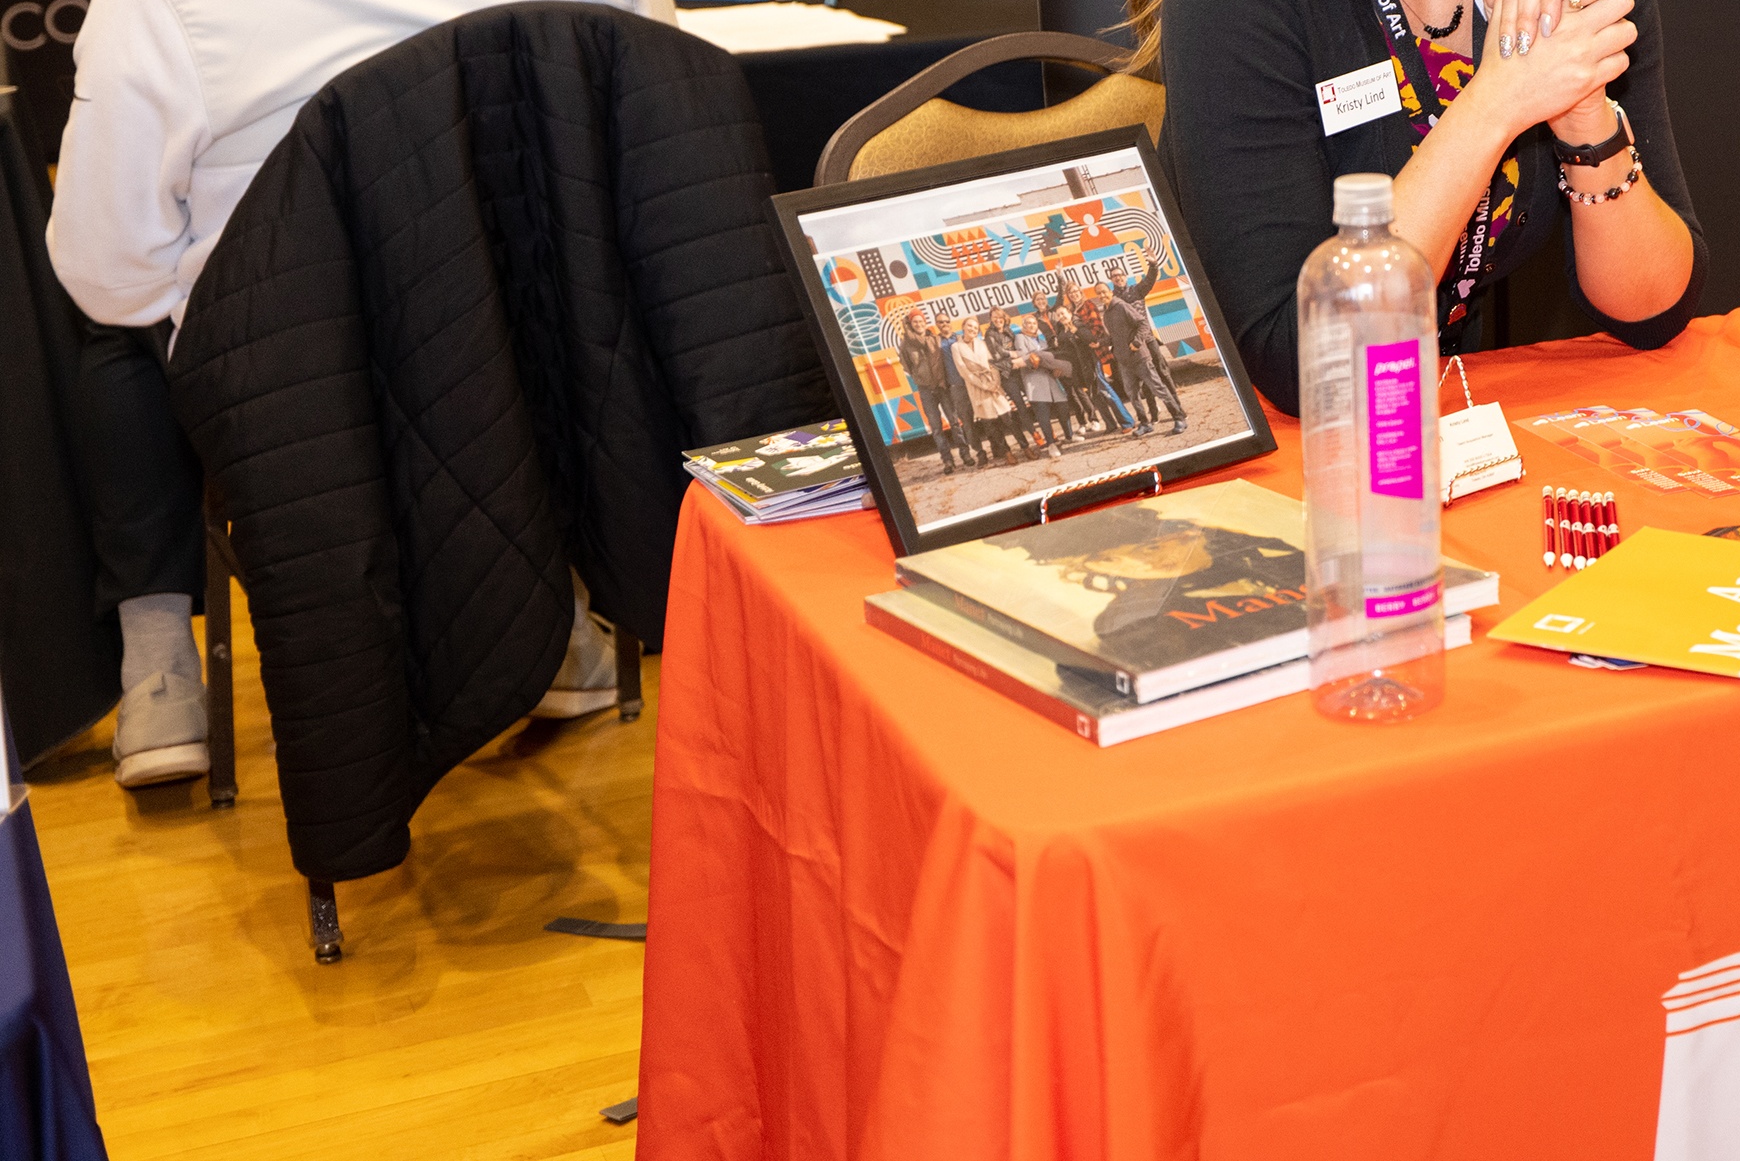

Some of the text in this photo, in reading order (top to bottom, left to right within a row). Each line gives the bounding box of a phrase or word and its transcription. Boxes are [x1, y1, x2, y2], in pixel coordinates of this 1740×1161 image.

[1386, 14, 1406, 40] Art
[1336, 88, 1385, 115] Kristy Lind
[1464, 224, 1486, 275] Toledo
[1164, 584, 1308, 629] Man
